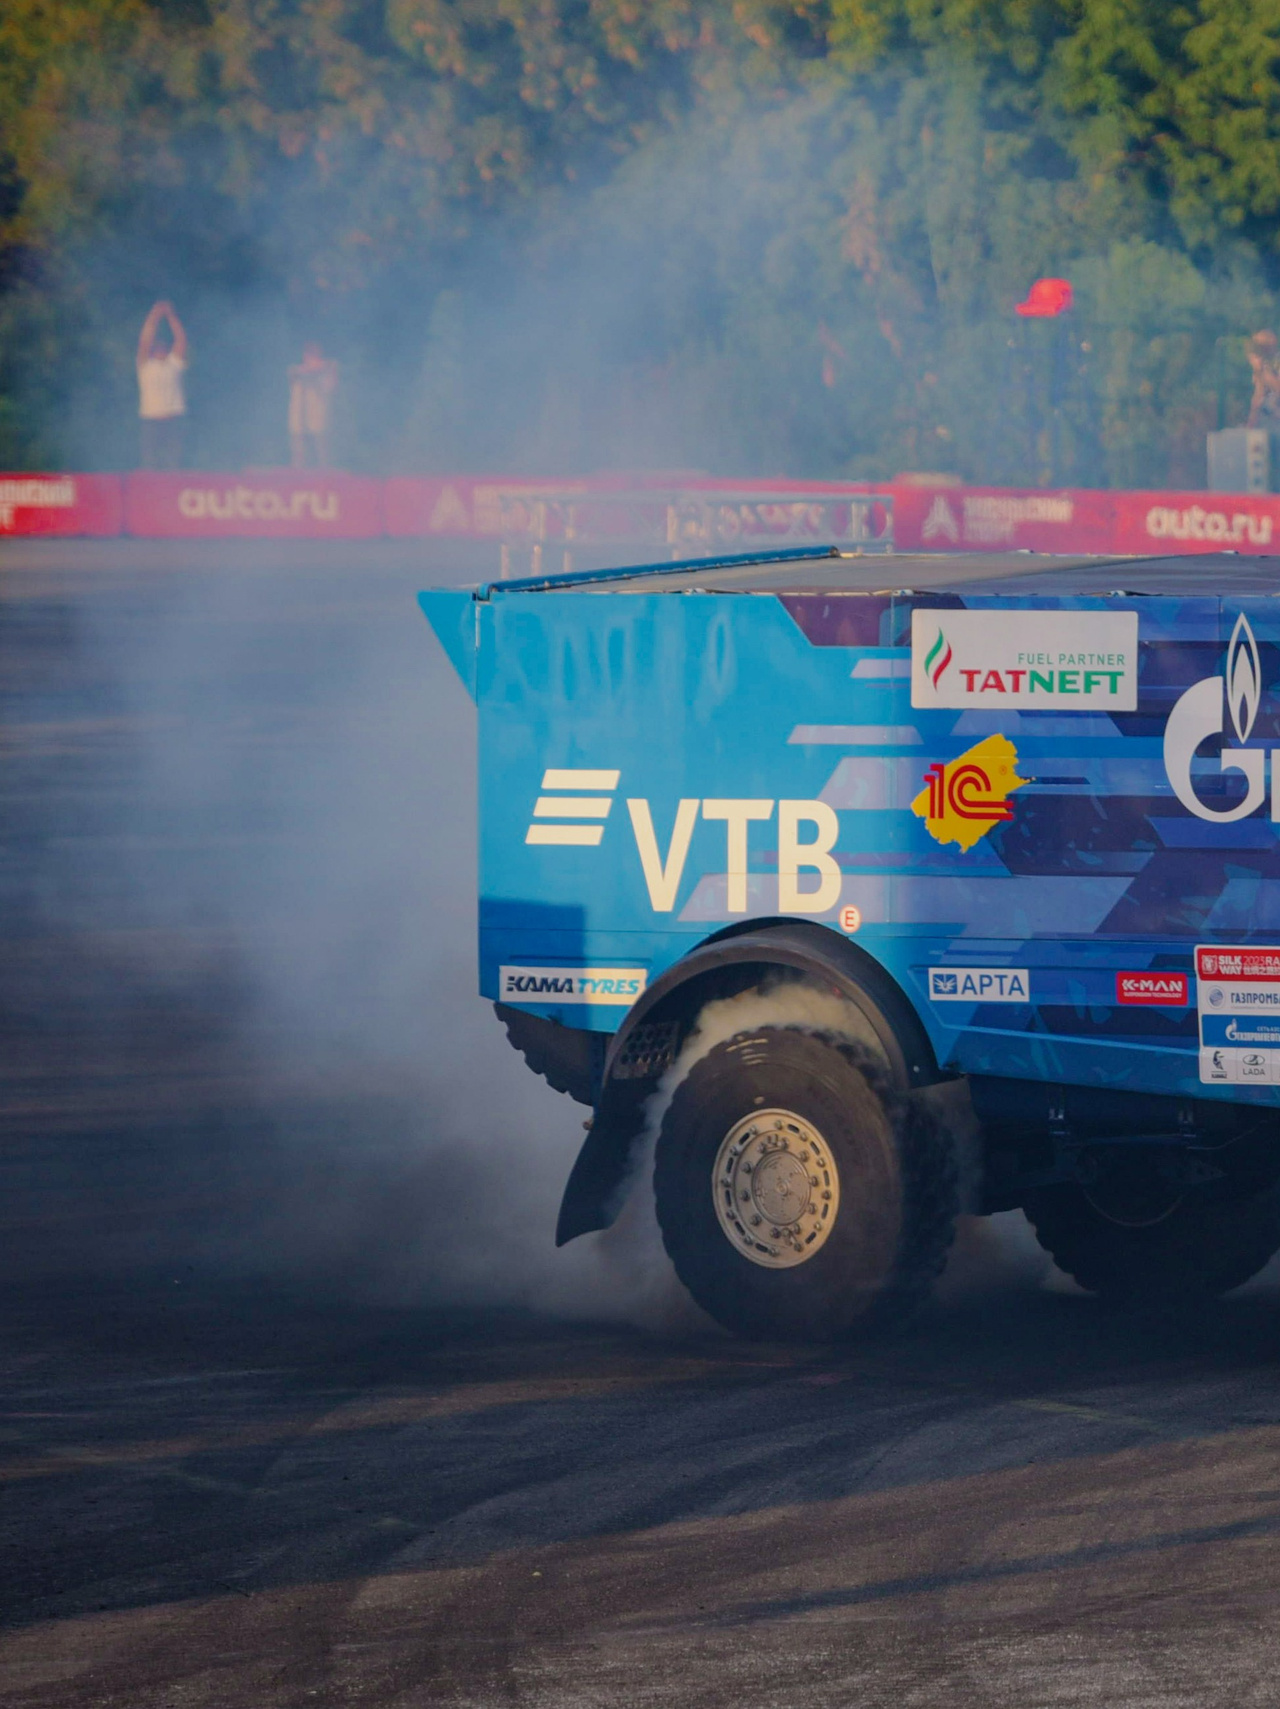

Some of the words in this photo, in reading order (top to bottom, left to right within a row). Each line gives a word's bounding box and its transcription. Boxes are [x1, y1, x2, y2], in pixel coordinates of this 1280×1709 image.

[178, 486, 339, 521] auto.ru
[1147, 504, 1273, 544] auto.ru
[1018, 653, 1054, 665] FUEL
[1059, 654, 1125, 665] PARTNER
[959, 669, 1125, 694] TATNEFT
[626, 798, 842, 913] VTB
[1219, 955, 1242, 965] SILK
[1220, 965, 1242, 975] WAY
[506, 975, 574, 993] KAMA
[577, 978, 640, 994] TYRES
[1122, 979, 1183, 992] K-MAN
[1242, 1068, 1266, 1076] LADA
